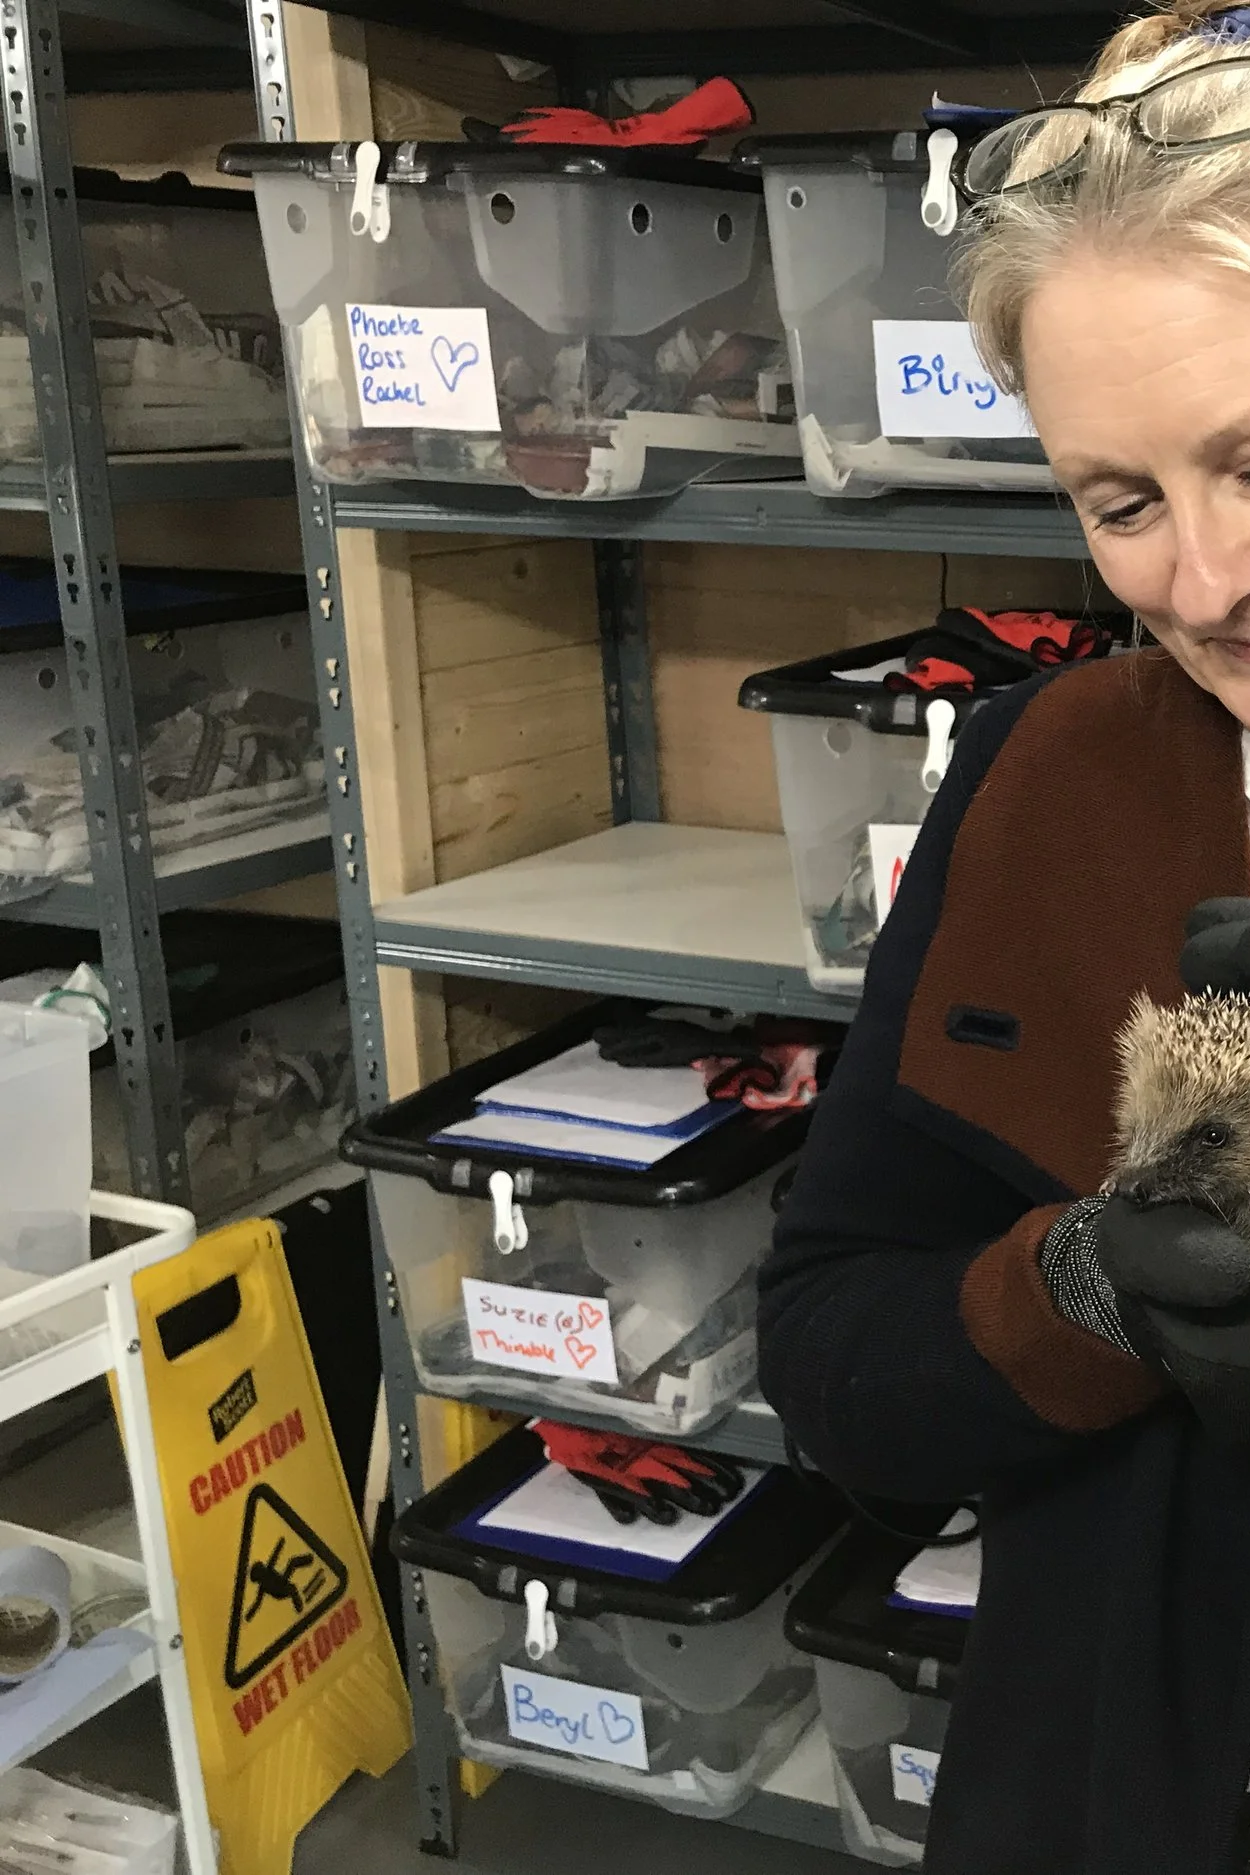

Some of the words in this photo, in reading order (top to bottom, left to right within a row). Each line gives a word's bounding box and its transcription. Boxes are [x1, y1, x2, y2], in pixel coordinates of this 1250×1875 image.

[350, 306, 424, 337] Phoebe
[358, 342, 406, 371] Ross
[362, 375, 427, 407] Rachel
[189, 1406, 306, 1516] CAUTION
[233, 1660, 289, 1737] WET
[289, 1597, 362, 1686] FLOOR
[513, 1683, 595, 1745] Beryl
